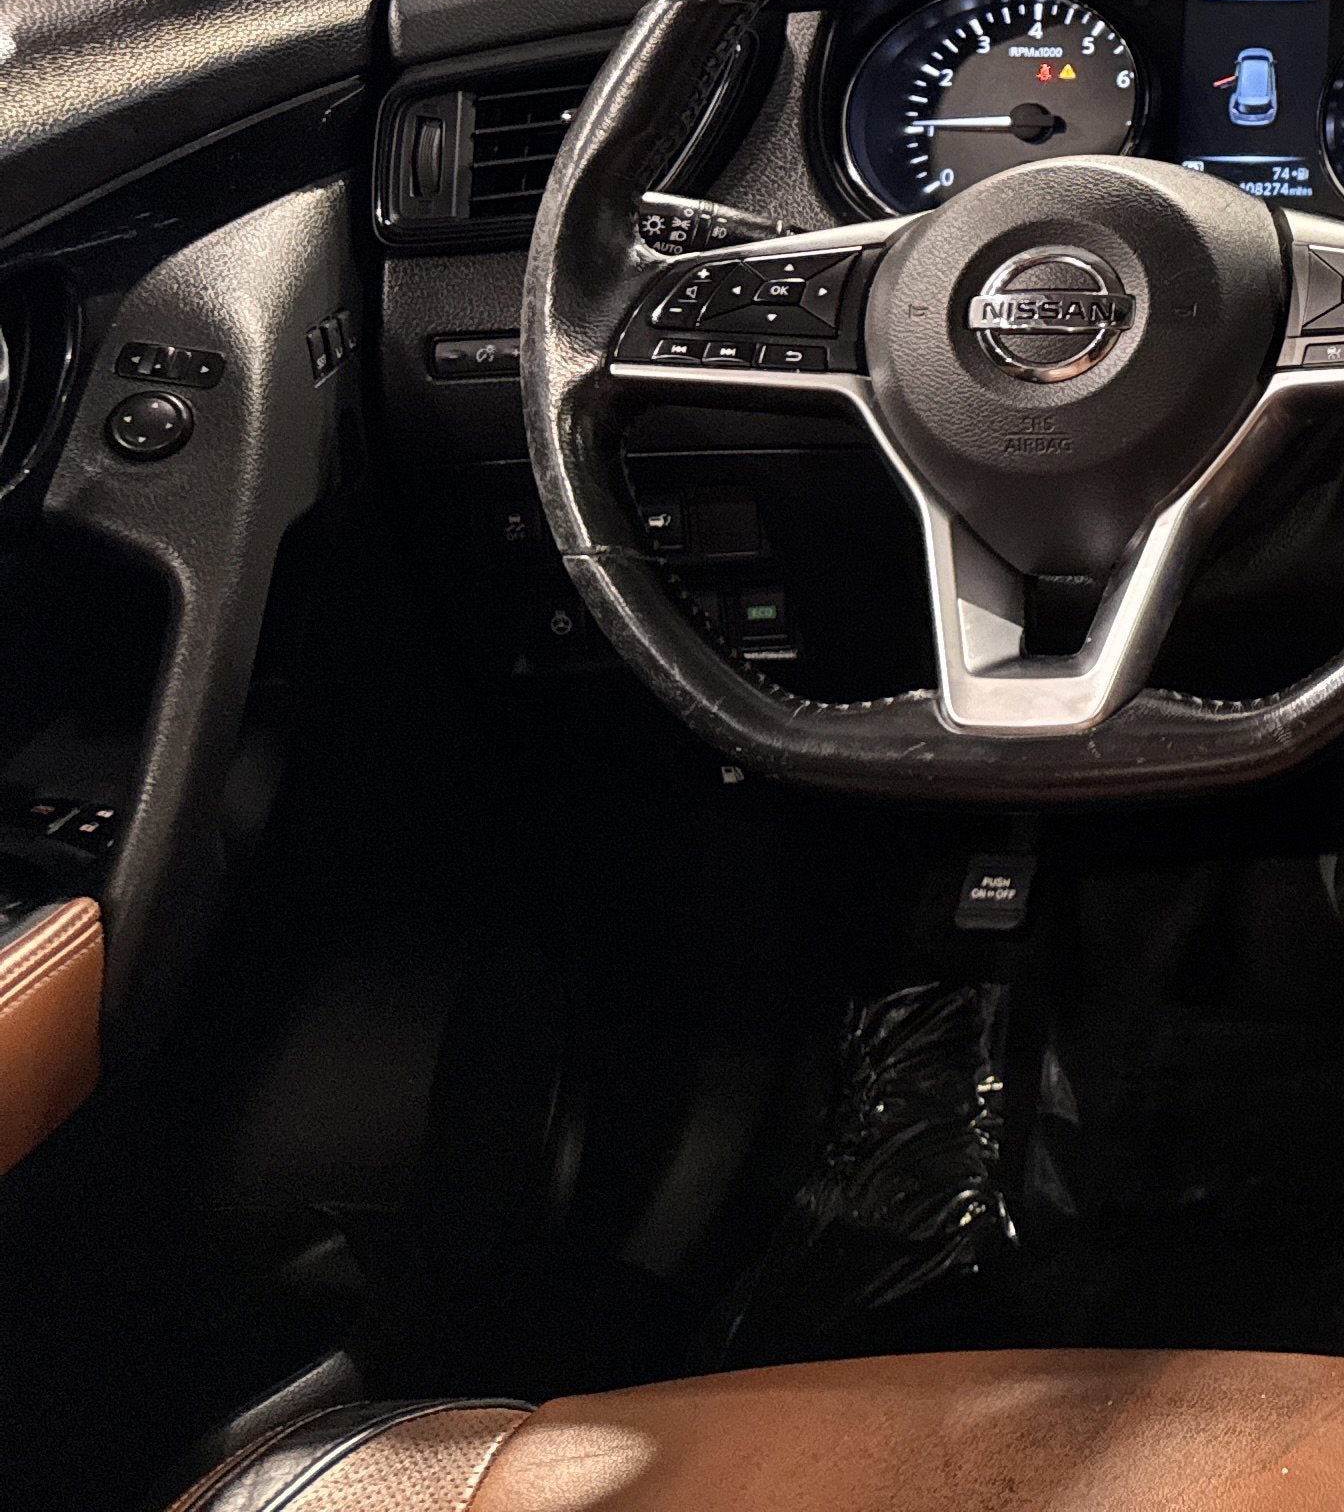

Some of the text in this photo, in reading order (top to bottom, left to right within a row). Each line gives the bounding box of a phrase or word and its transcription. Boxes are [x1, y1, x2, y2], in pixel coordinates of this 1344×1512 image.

[1028, 22, 1043, 39] 4
[976, 35, 991, 54] 3
[1082, 37, 1095, 55] 5
[938, 69, 953, 87] 2
[1116, 70, 1131, 88] 6
[939, 168, 955, 185] 0
[1272, 167, 1289, 180] 74
[653, 241, 683, 255] AUTO
[770, 285, 789, 296] OK
[982, 300, 1117, 323] NISSAN
[1003, 438, 1074, 454] AIRBAG
[751, 607, 773, 617] ECO
[981, 877, 1011, 887] PUSH
